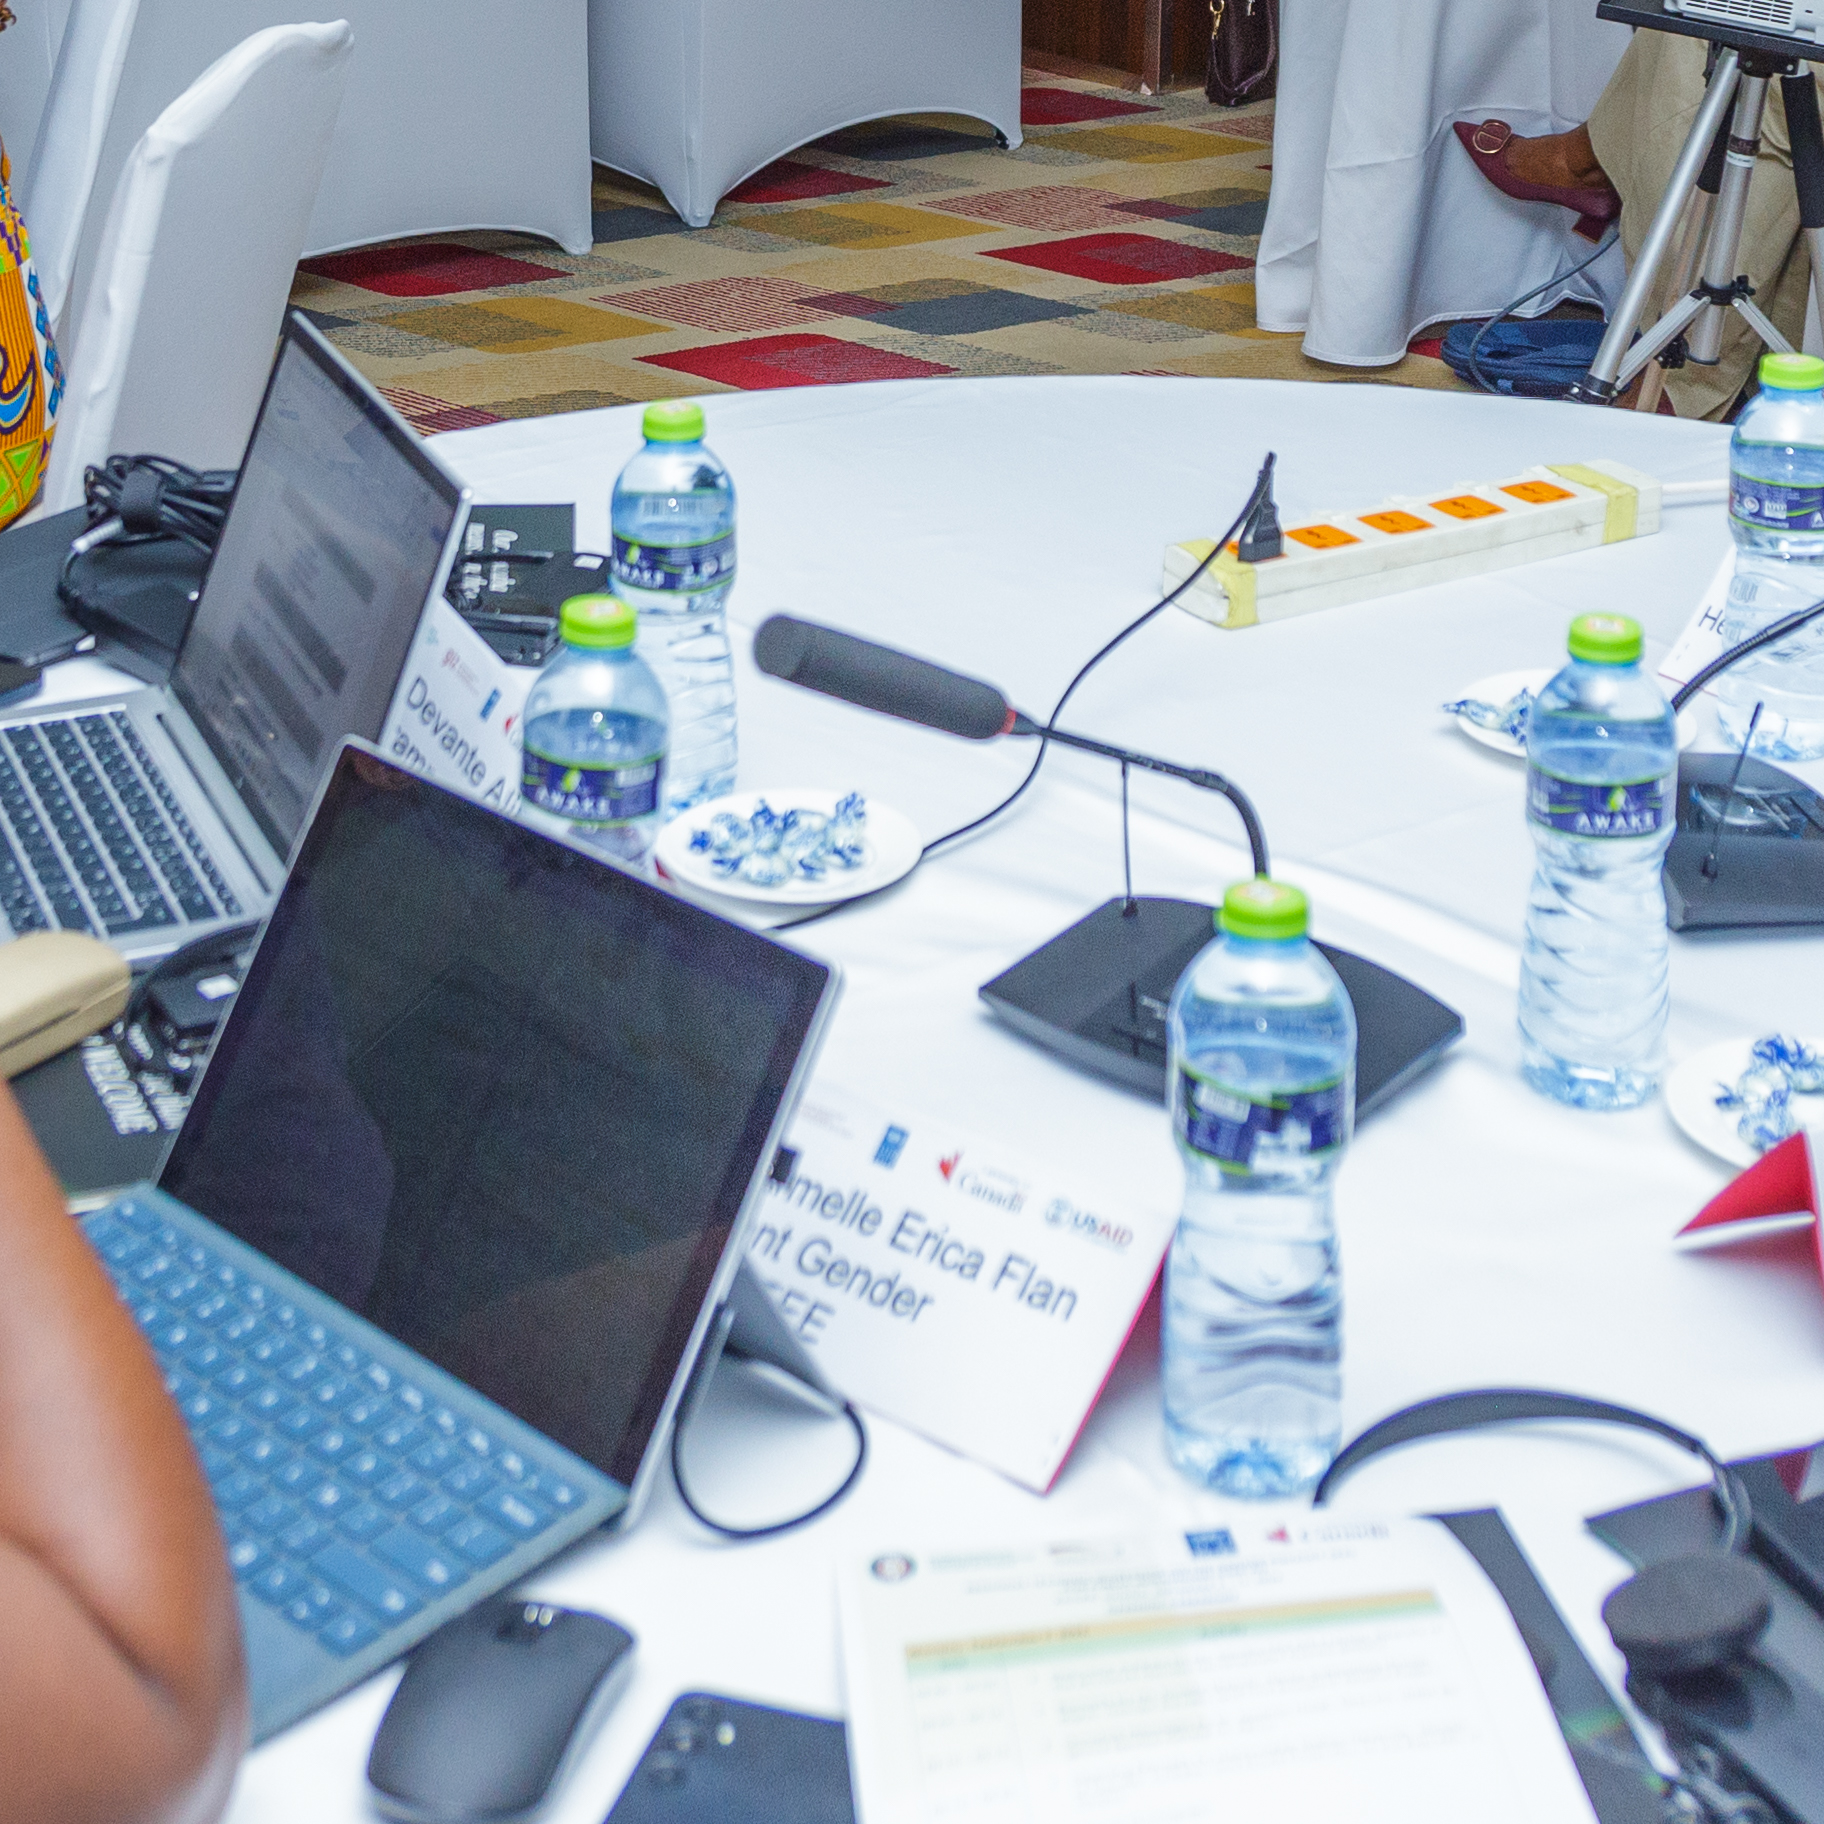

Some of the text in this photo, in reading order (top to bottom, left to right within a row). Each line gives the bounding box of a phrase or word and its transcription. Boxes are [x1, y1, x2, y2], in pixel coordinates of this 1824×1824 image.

[407, 677, 486, 786] Devante
[890, 1208, 985, 1281] Erica
[992, 1254, 1078, 1321] Flan
[1074, 1211, 1133, 1247] USAID
[798, 1238, 935, 1322] Gender
